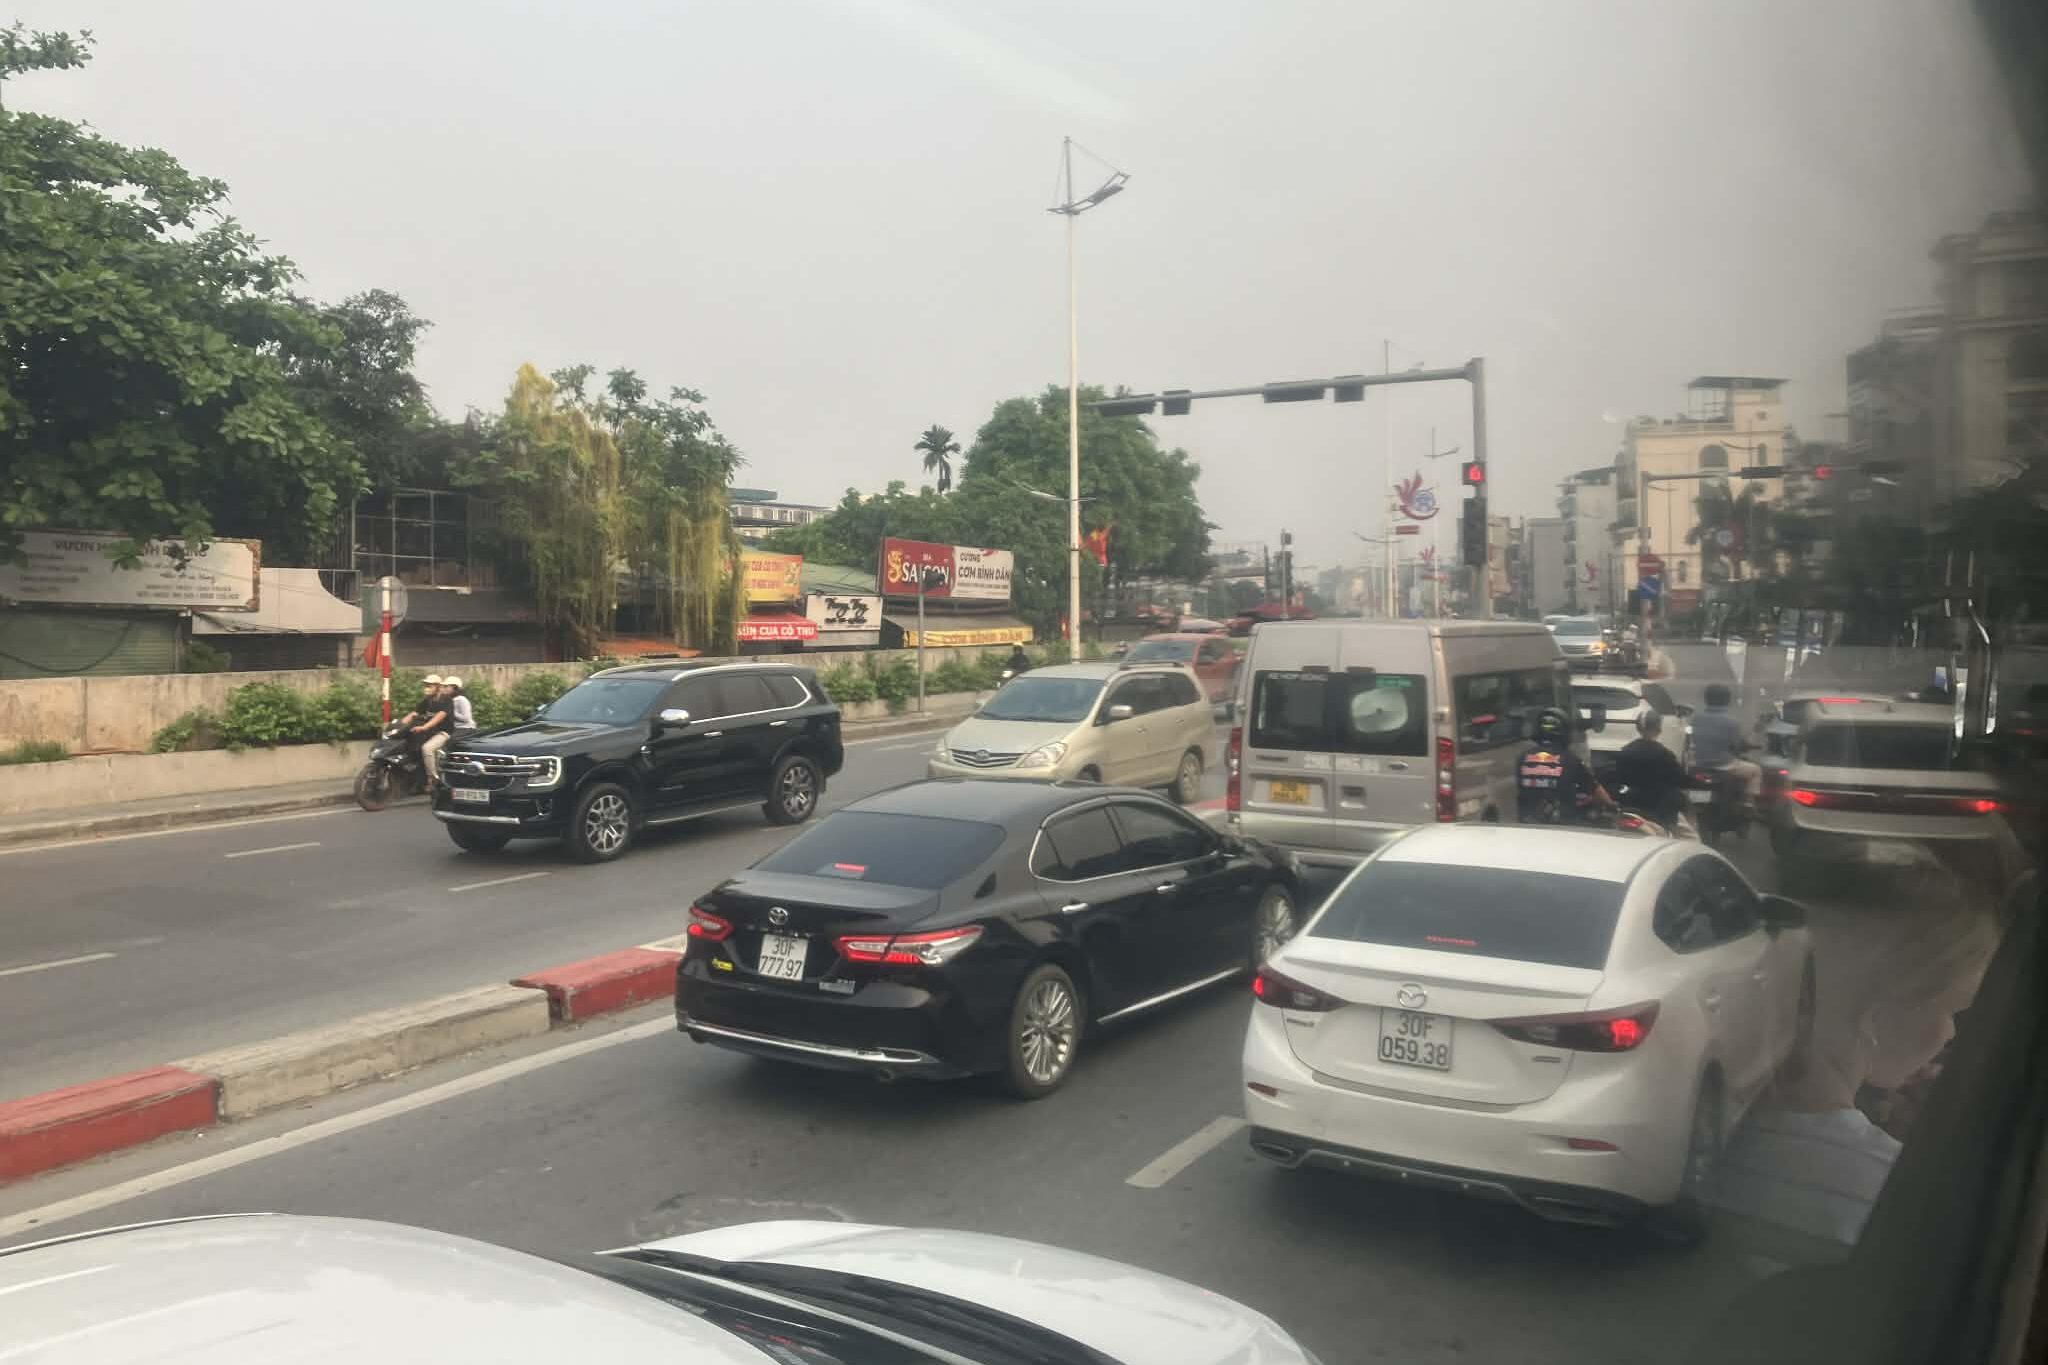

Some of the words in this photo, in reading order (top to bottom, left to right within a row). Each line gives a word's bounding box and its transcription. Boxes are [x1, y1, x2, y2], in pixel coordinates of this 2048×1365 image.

[772, 937, 799, 956] 30F
[759, 955, 803, 978] 777.97
[1397, 1012, 1436, 1039] 30F
[1381, 1036, 1449, 1066] 059.38
